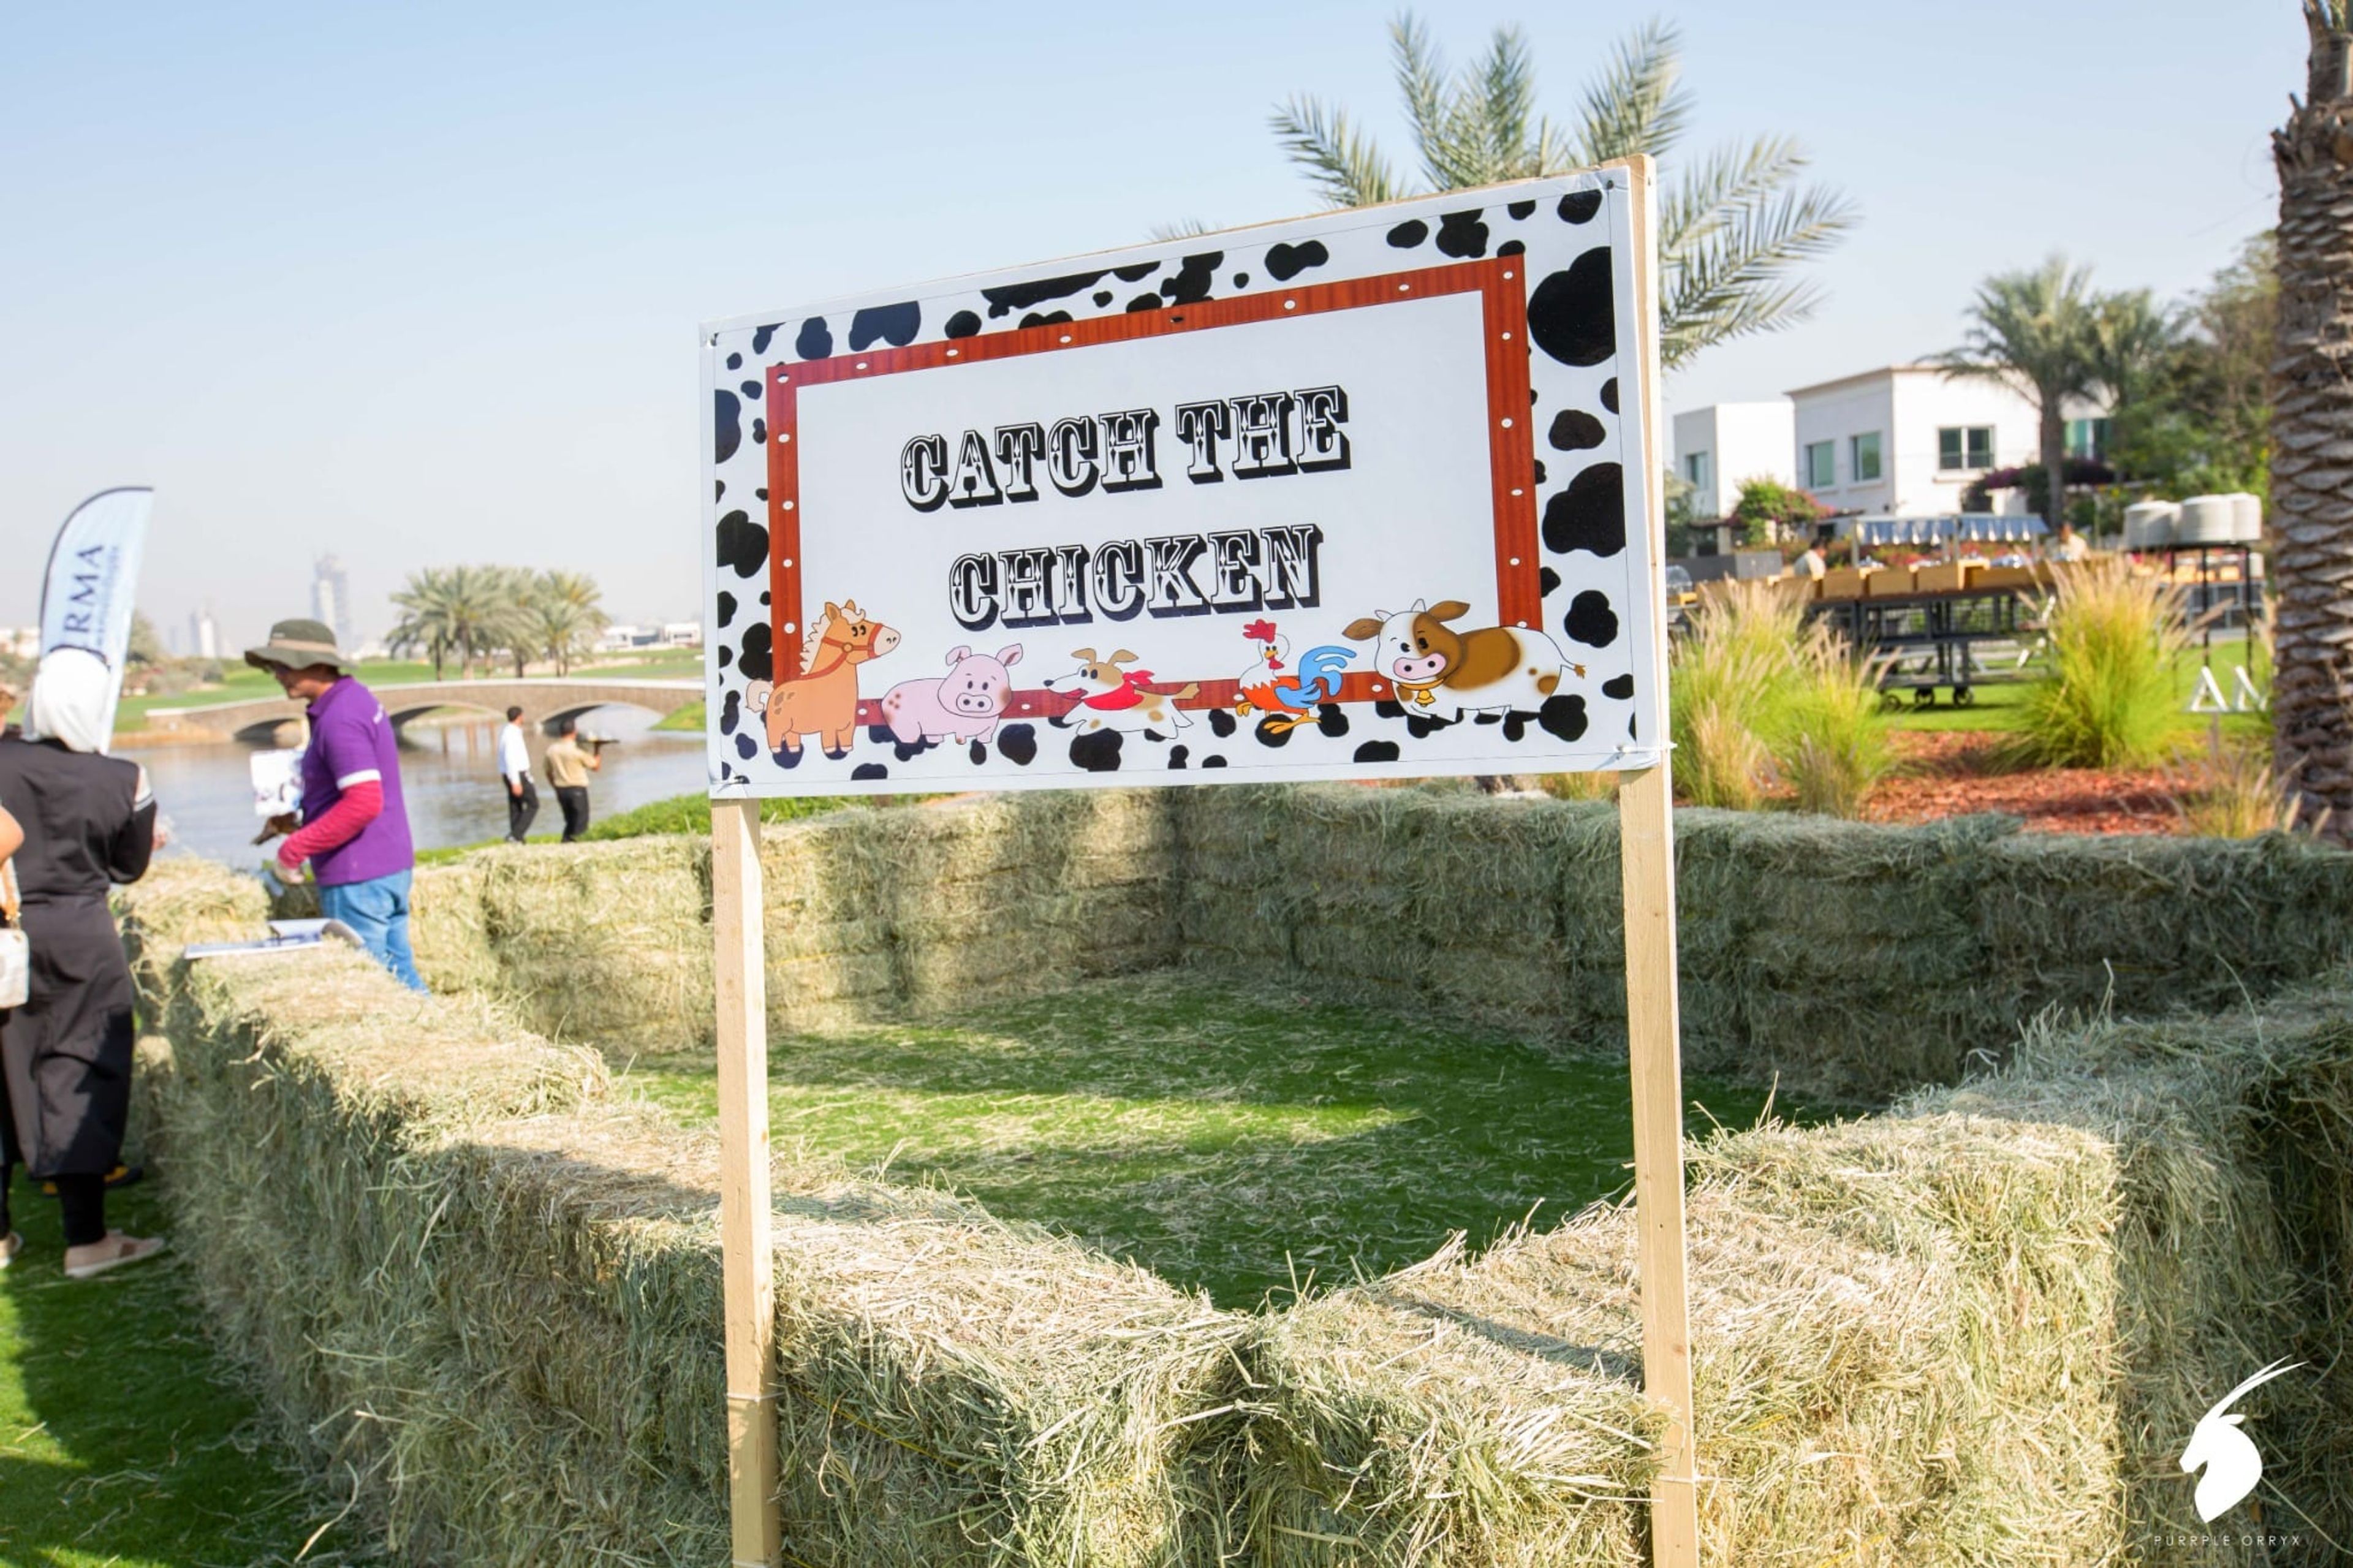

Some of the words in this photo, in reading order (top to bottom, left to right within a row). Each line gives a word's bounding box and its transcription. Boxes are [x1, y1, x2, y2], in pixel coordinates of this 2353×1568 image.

[900, 408, 1162, 512] CATCH
[1175, 385, 1351, 484] THE
[64, 545, 104, 633] RMA
[949, 523, 1324, 631] CHICKEN
